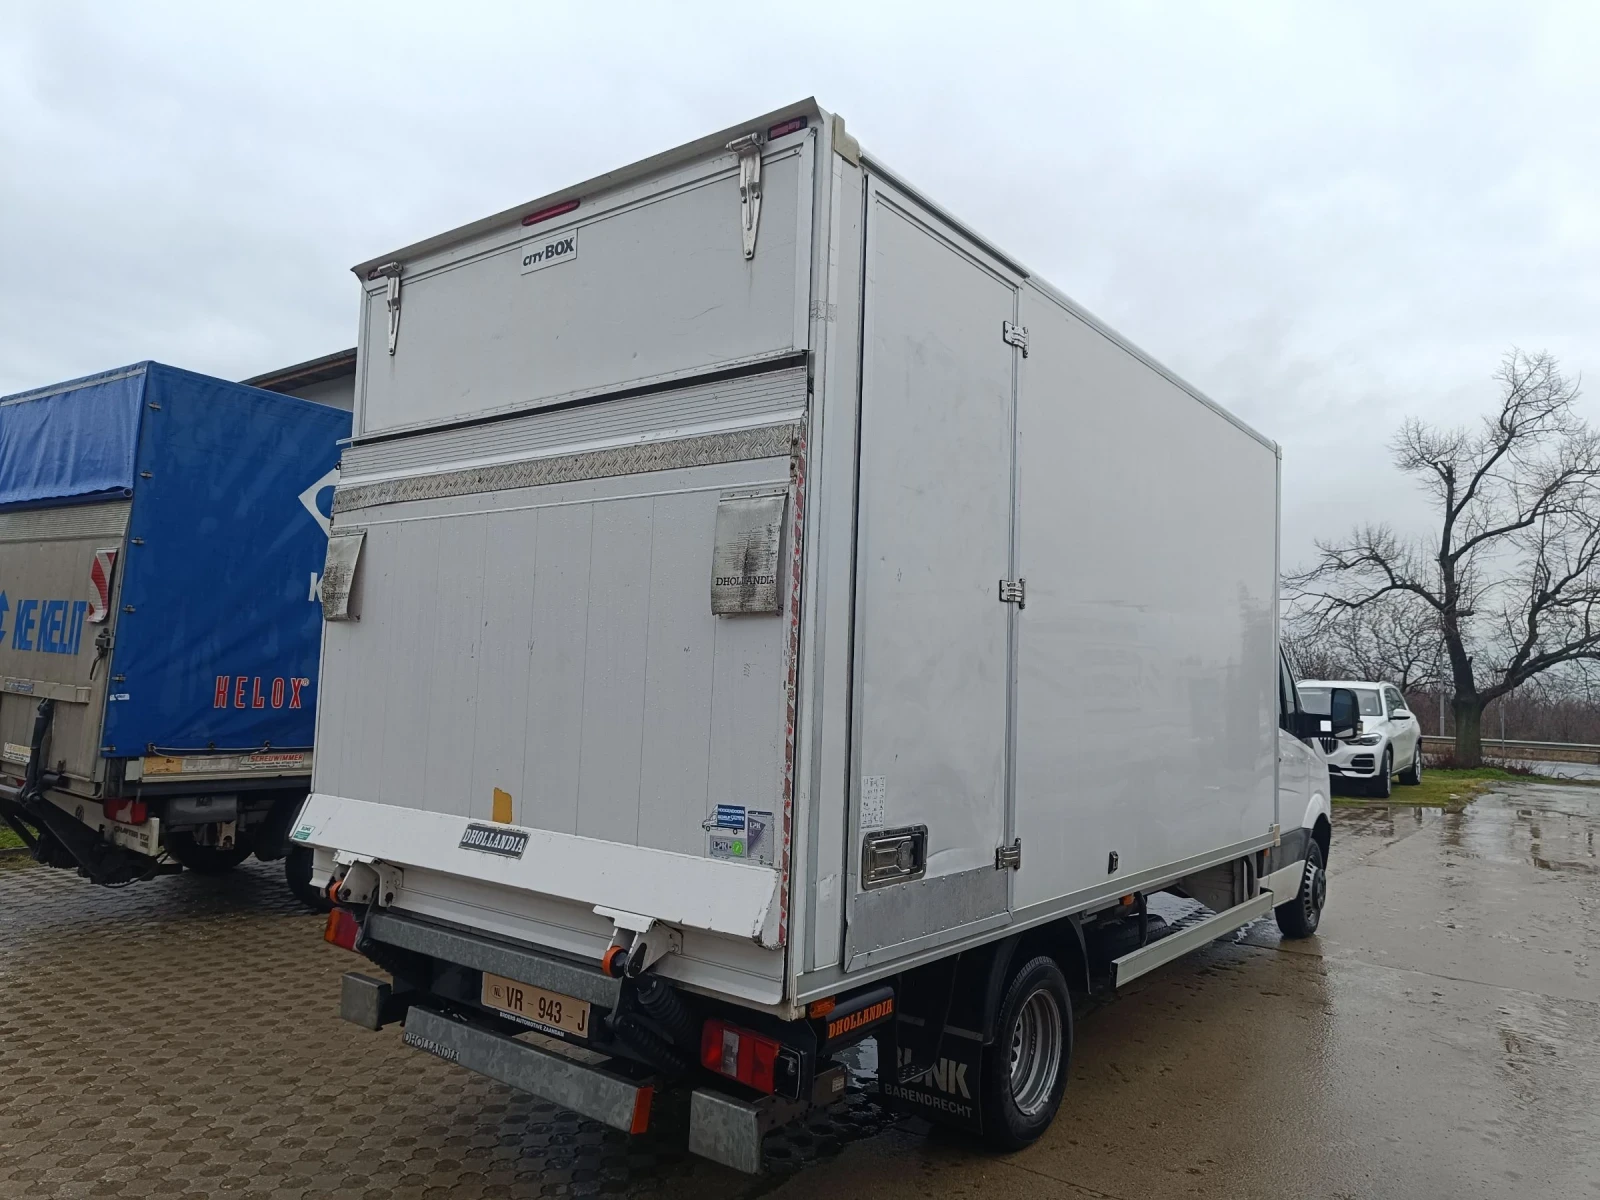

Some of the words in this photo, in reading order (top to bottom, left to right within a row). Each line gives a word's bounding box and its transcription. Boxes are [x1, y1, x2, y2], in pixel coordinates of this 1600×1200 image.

[523, 250, 545, 267] CITY
[545, 236, 575, 260] BOX
[12, 599, 38, 651] KE
[462, 828, 525, 853] DHOLLANDIA
[493, 986, 501, 998] NL
[506, 986, 524, 1012] VR
[538, 997, 562, 1024] 943
[577, 1010, 586, 1032] J
[828, 998, 893, 1039] DHOLLANDIA
[403, 1031, 460, 1062] DHOLLANDIA
[884, 1083, 973, 1119] BARENDRECHT
